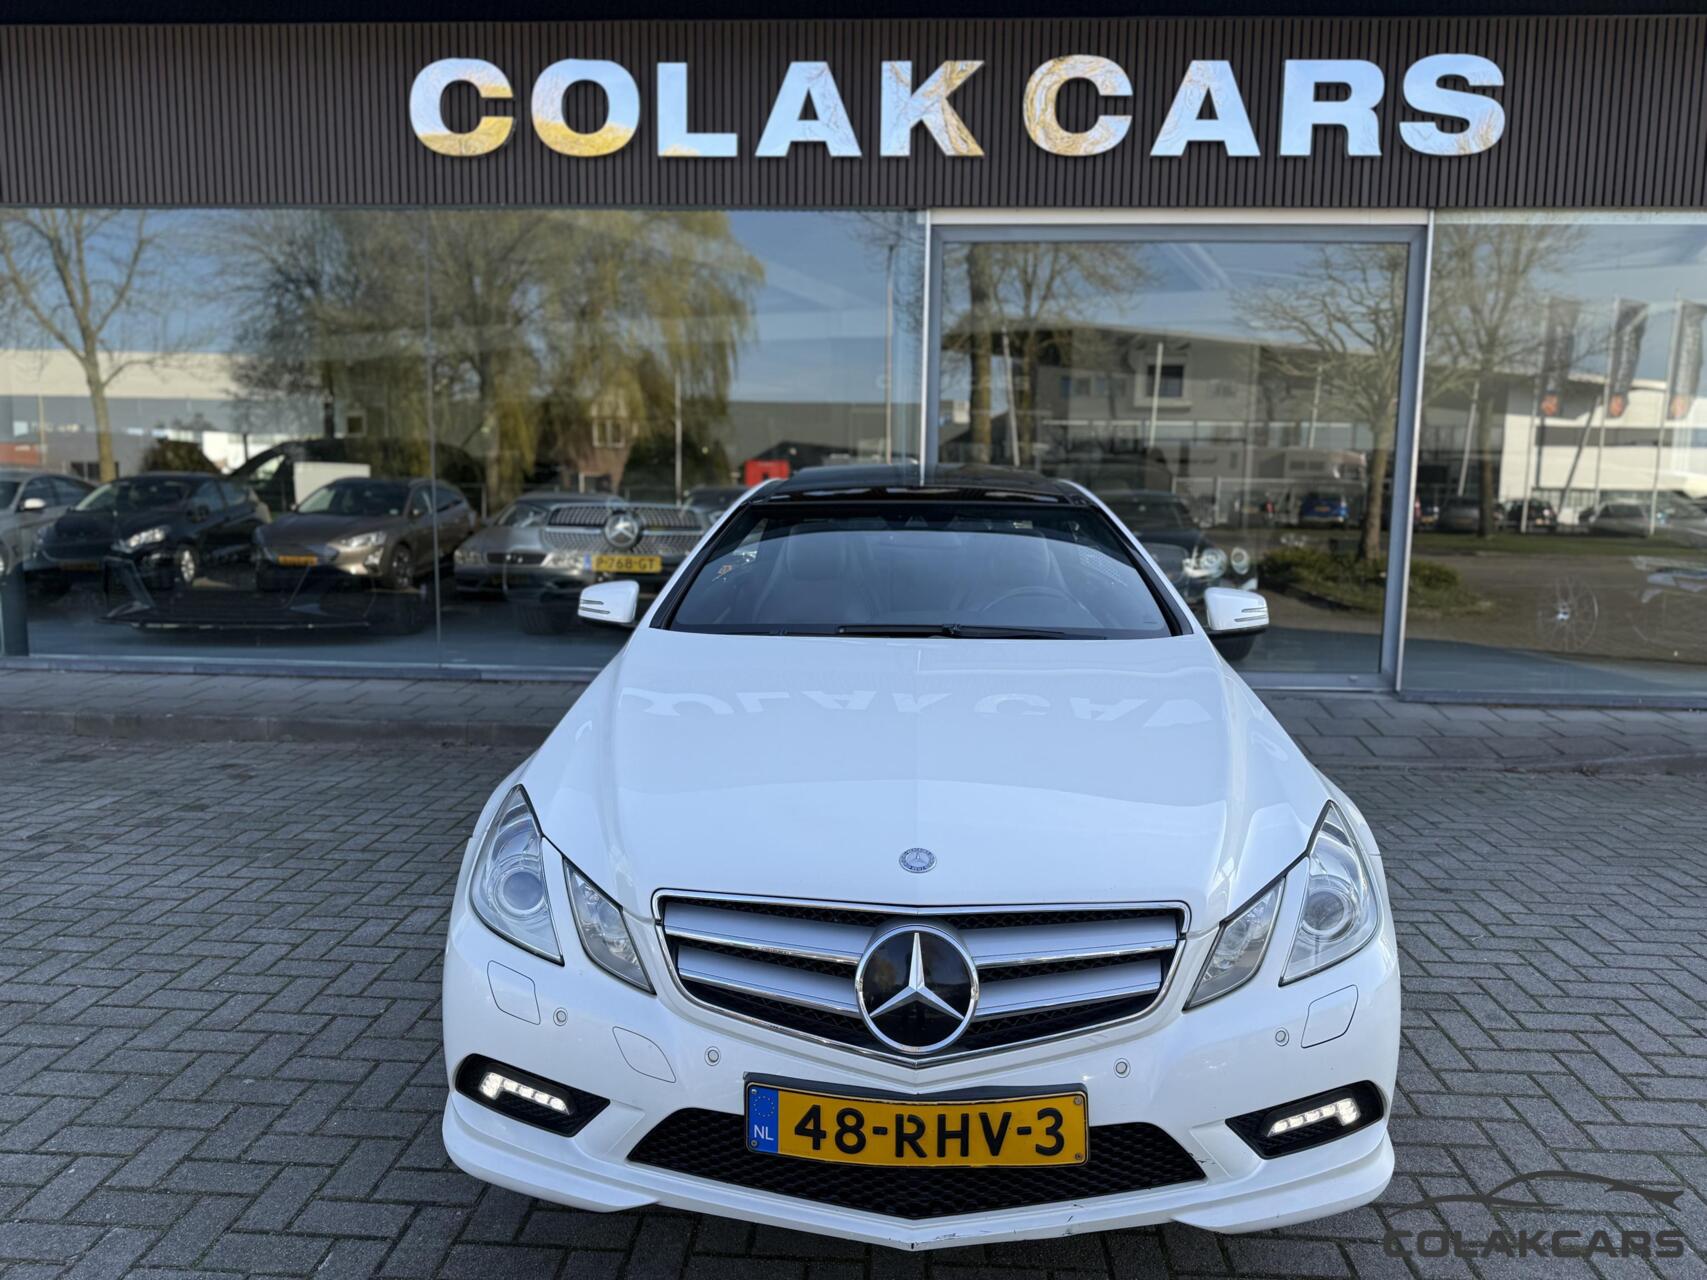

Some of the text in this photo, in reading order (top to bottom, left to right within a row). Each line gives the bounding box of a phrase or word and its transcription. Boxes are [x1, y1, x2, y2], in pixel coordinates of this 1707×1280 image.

[408, 53, 1506, 158] COLAK CARS
[753, 1104, 1066, 1159] NL 48-RHV-3
